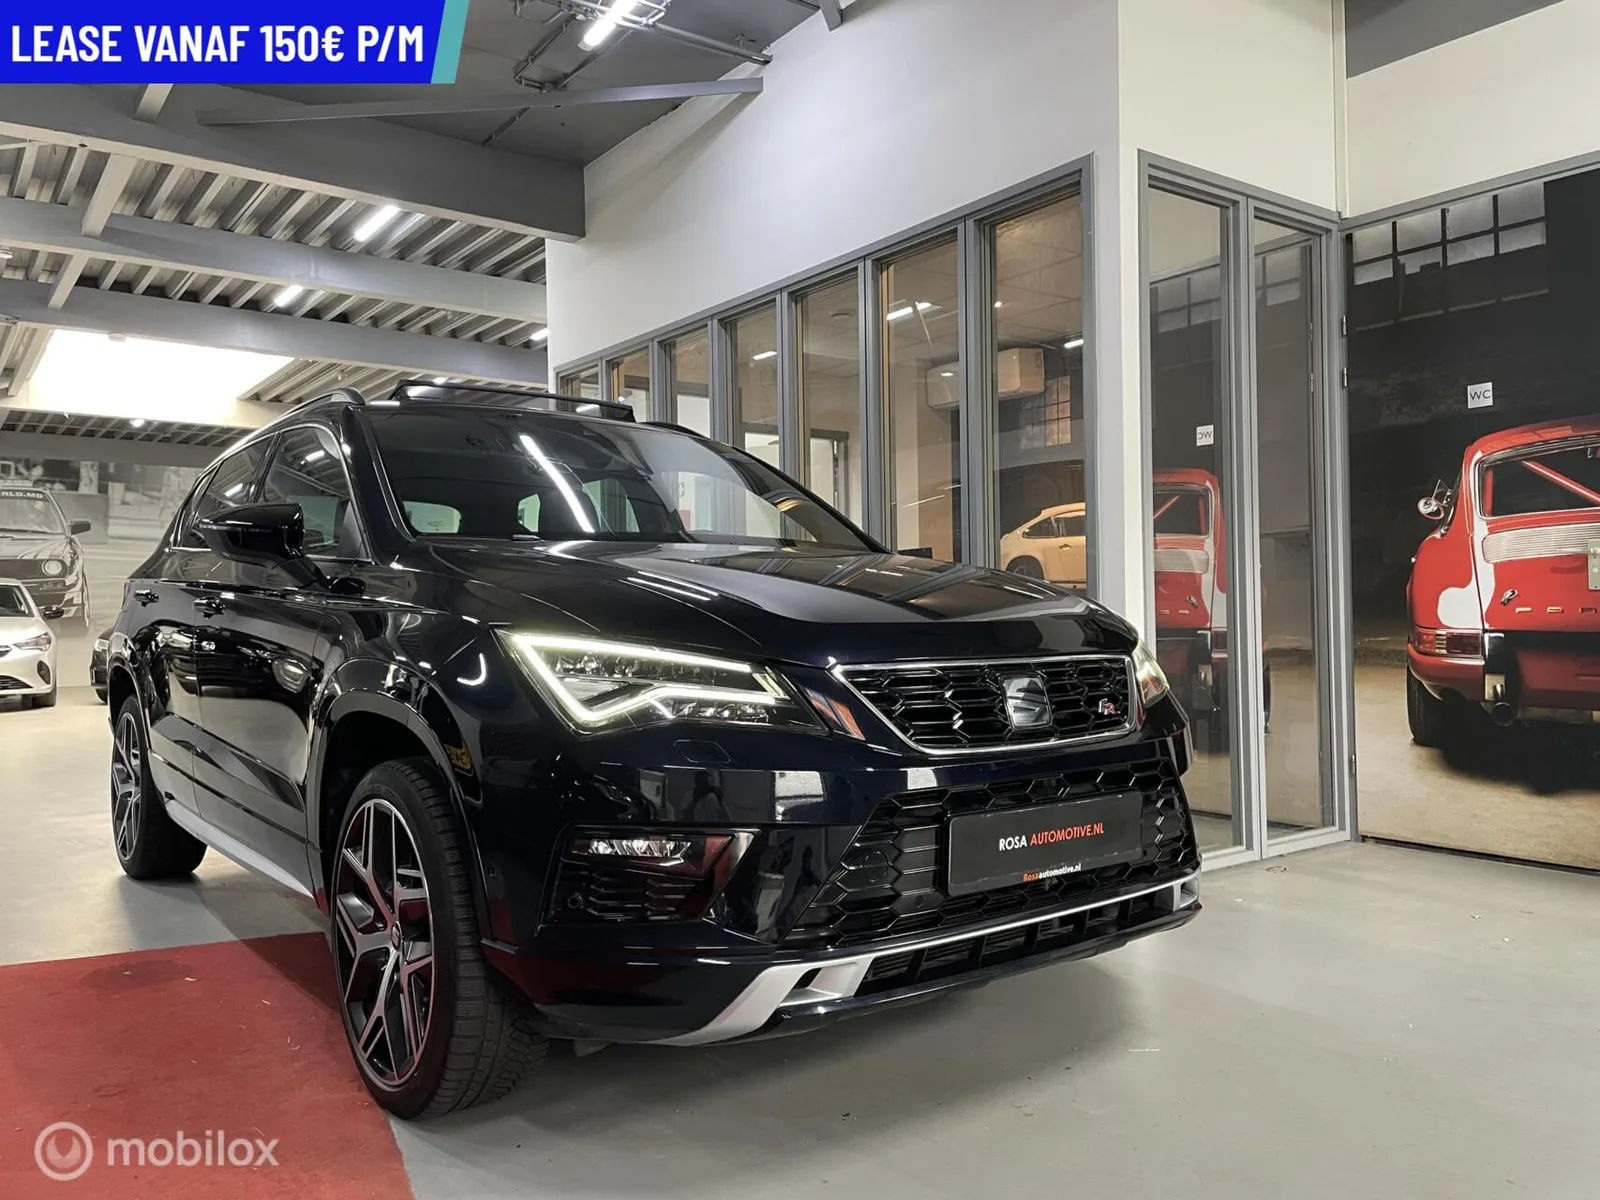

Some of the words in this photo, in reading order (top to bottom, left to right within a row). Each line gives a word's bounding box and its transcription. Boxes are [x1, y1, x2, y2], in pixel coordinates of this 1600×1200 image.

[1469, 390, 1491, 400] WC
[0, 491, 44, 499] RLD.MD
[999, 835, 1028, 851] ROSA
[1030, 822, 1105, 846] AUTOMOTIVE.NL
[1023, 863, 1082, 882] Rosaautomotive.nl
